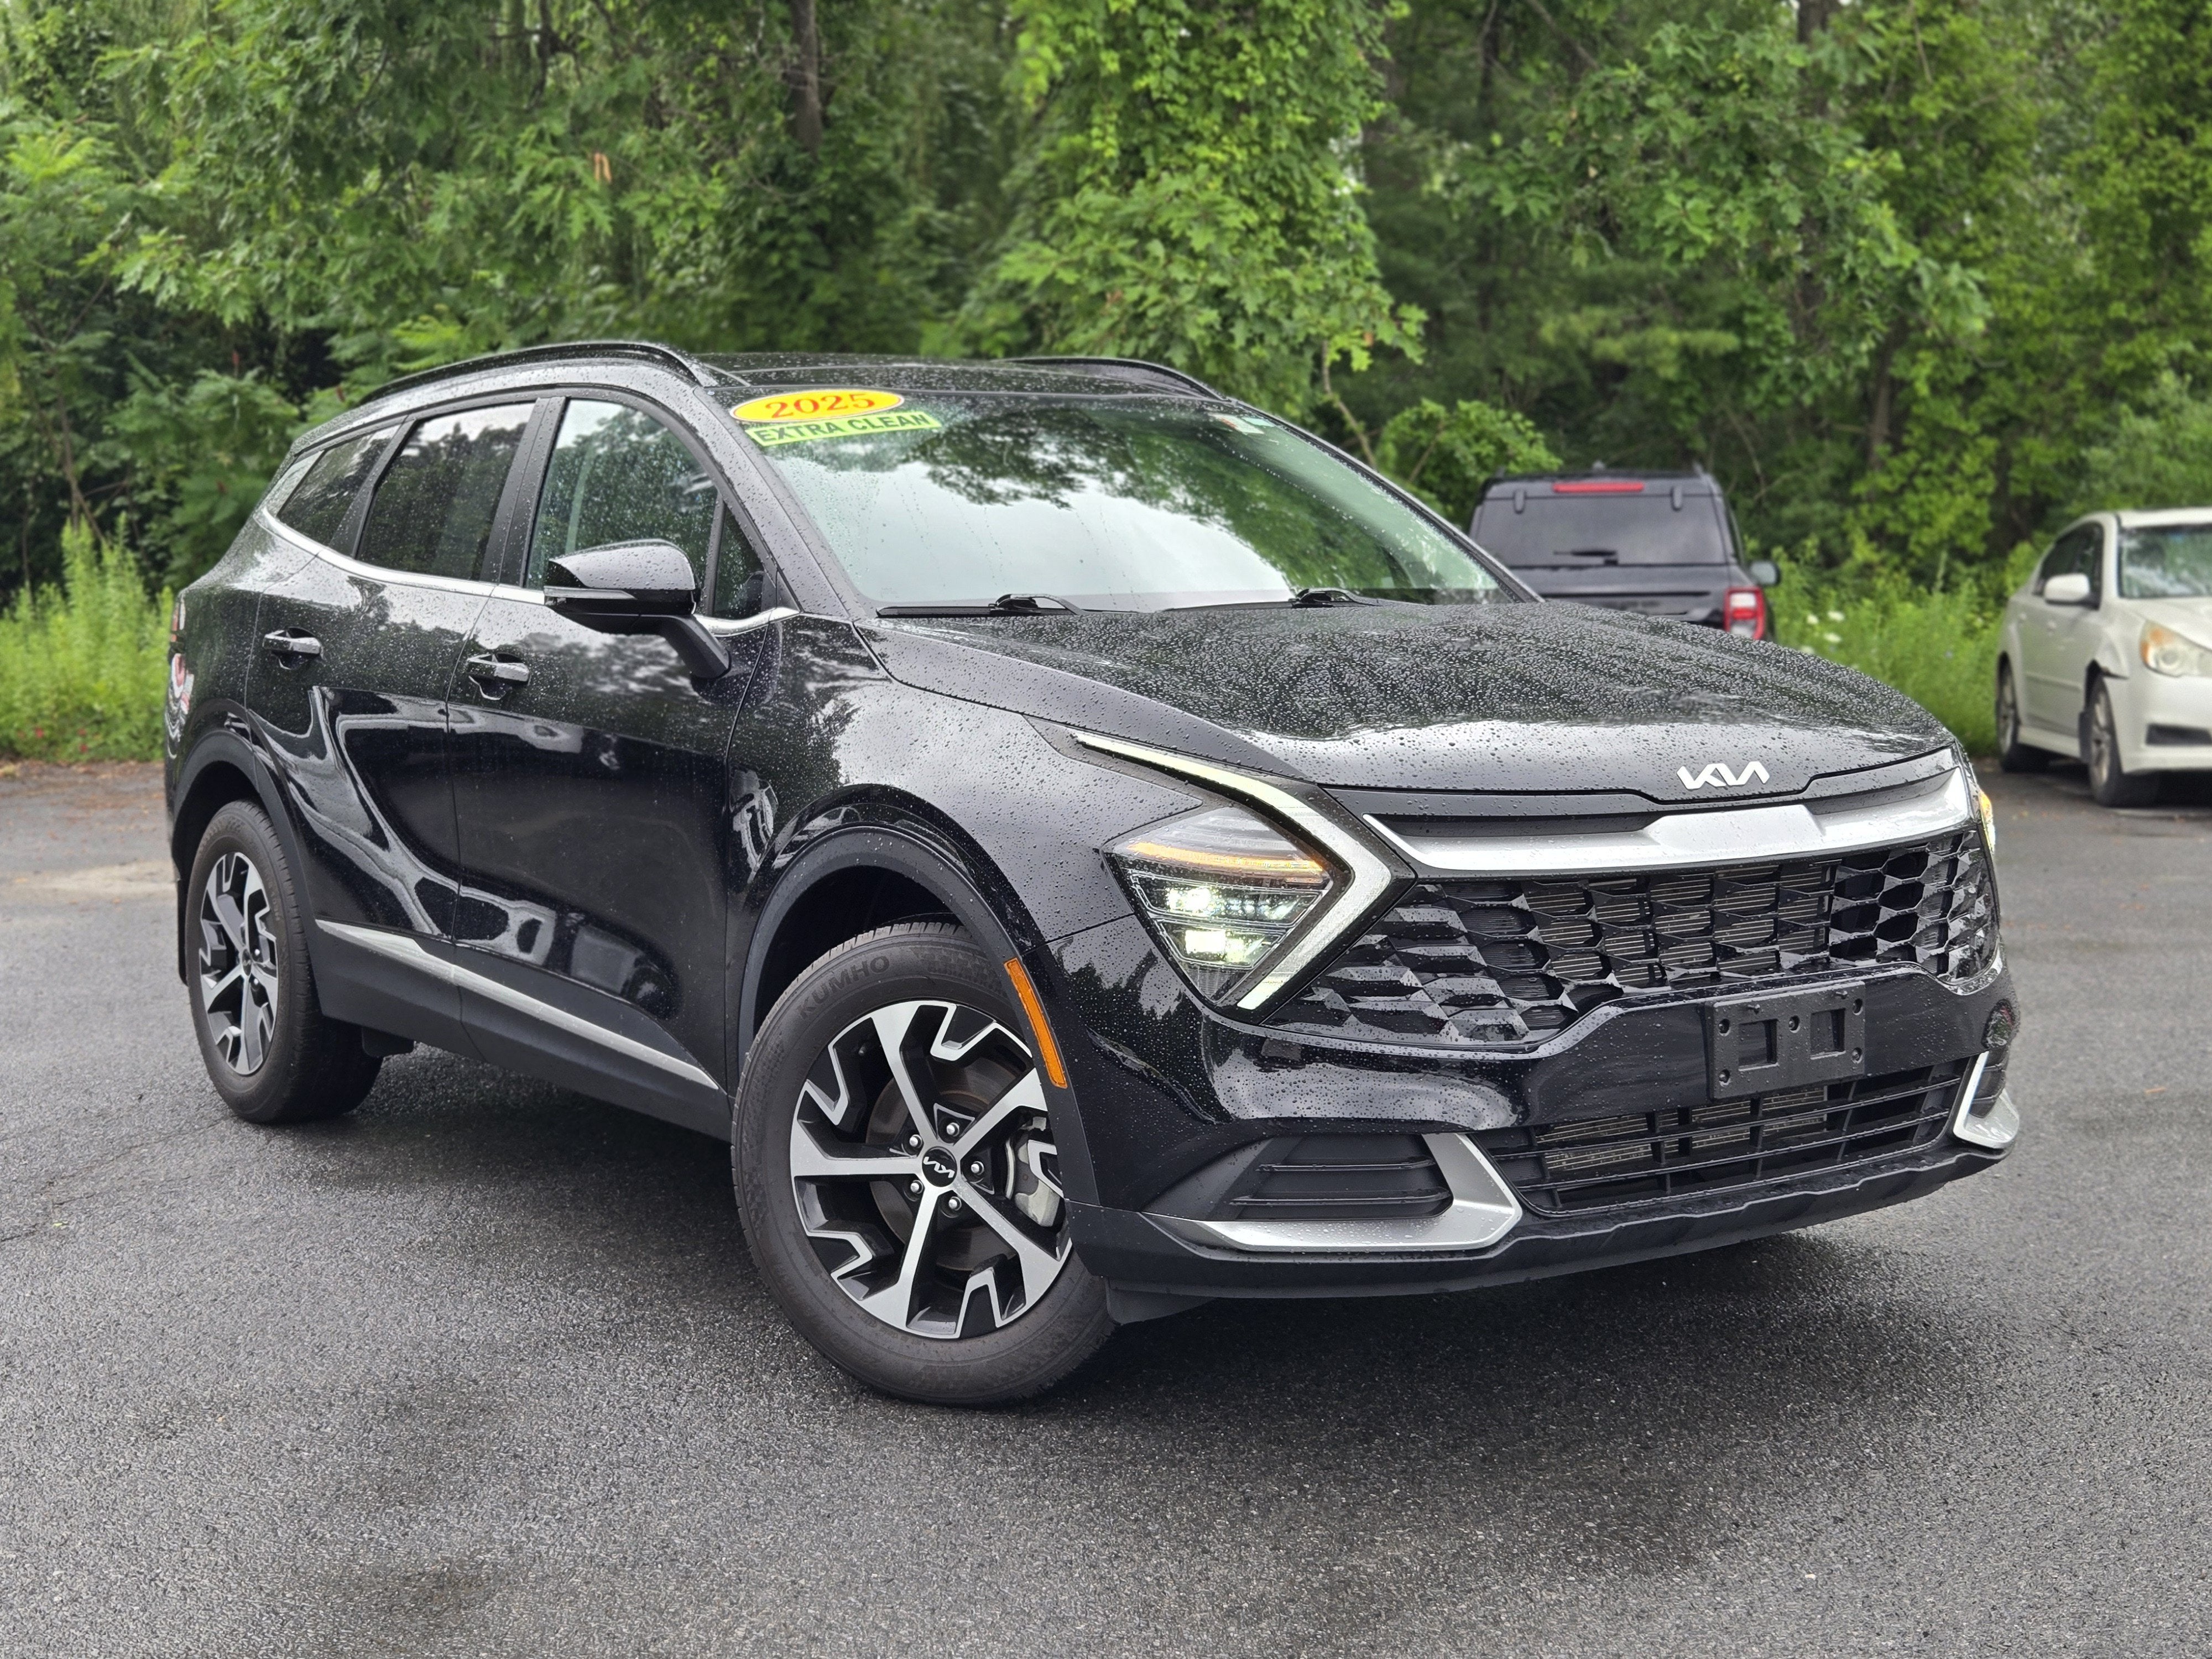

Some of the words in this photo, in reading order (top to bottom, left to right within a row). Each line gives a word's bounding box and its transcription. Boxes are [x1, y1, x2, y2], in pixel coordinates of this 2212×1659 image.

[765, 393, 875, 419] 2025
[754, 422, 843, 442] EXTRA
[847, 414, 930, 430] CLEAN
[1676, 761, 1770, 790] KIA
[797, 956, 889, 1020] KUMHO
